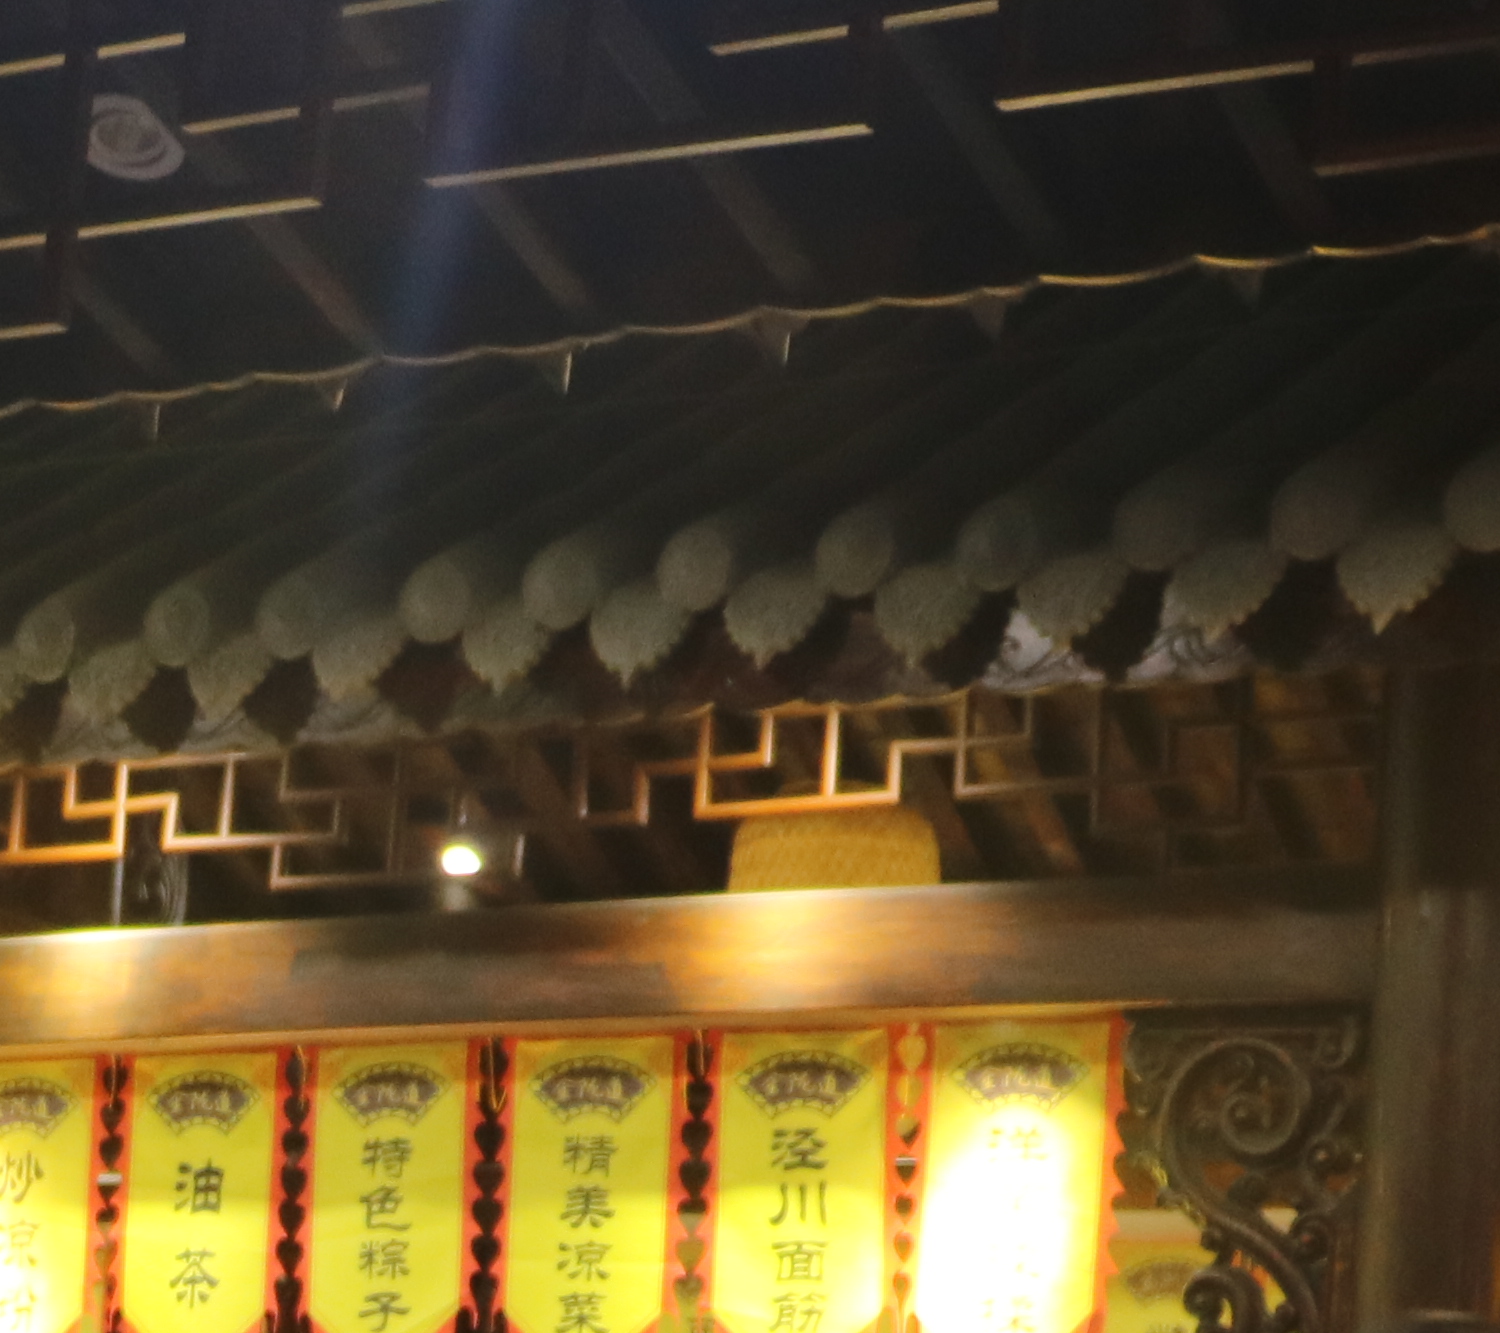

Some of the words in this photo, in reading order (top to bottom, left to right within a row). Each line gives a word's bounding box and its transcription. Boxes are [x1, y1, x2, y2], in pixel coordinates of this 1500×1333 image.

[170, 1158, 224, 1309] 油茶
[359, 1136, 413, 1333] 特色粽子
